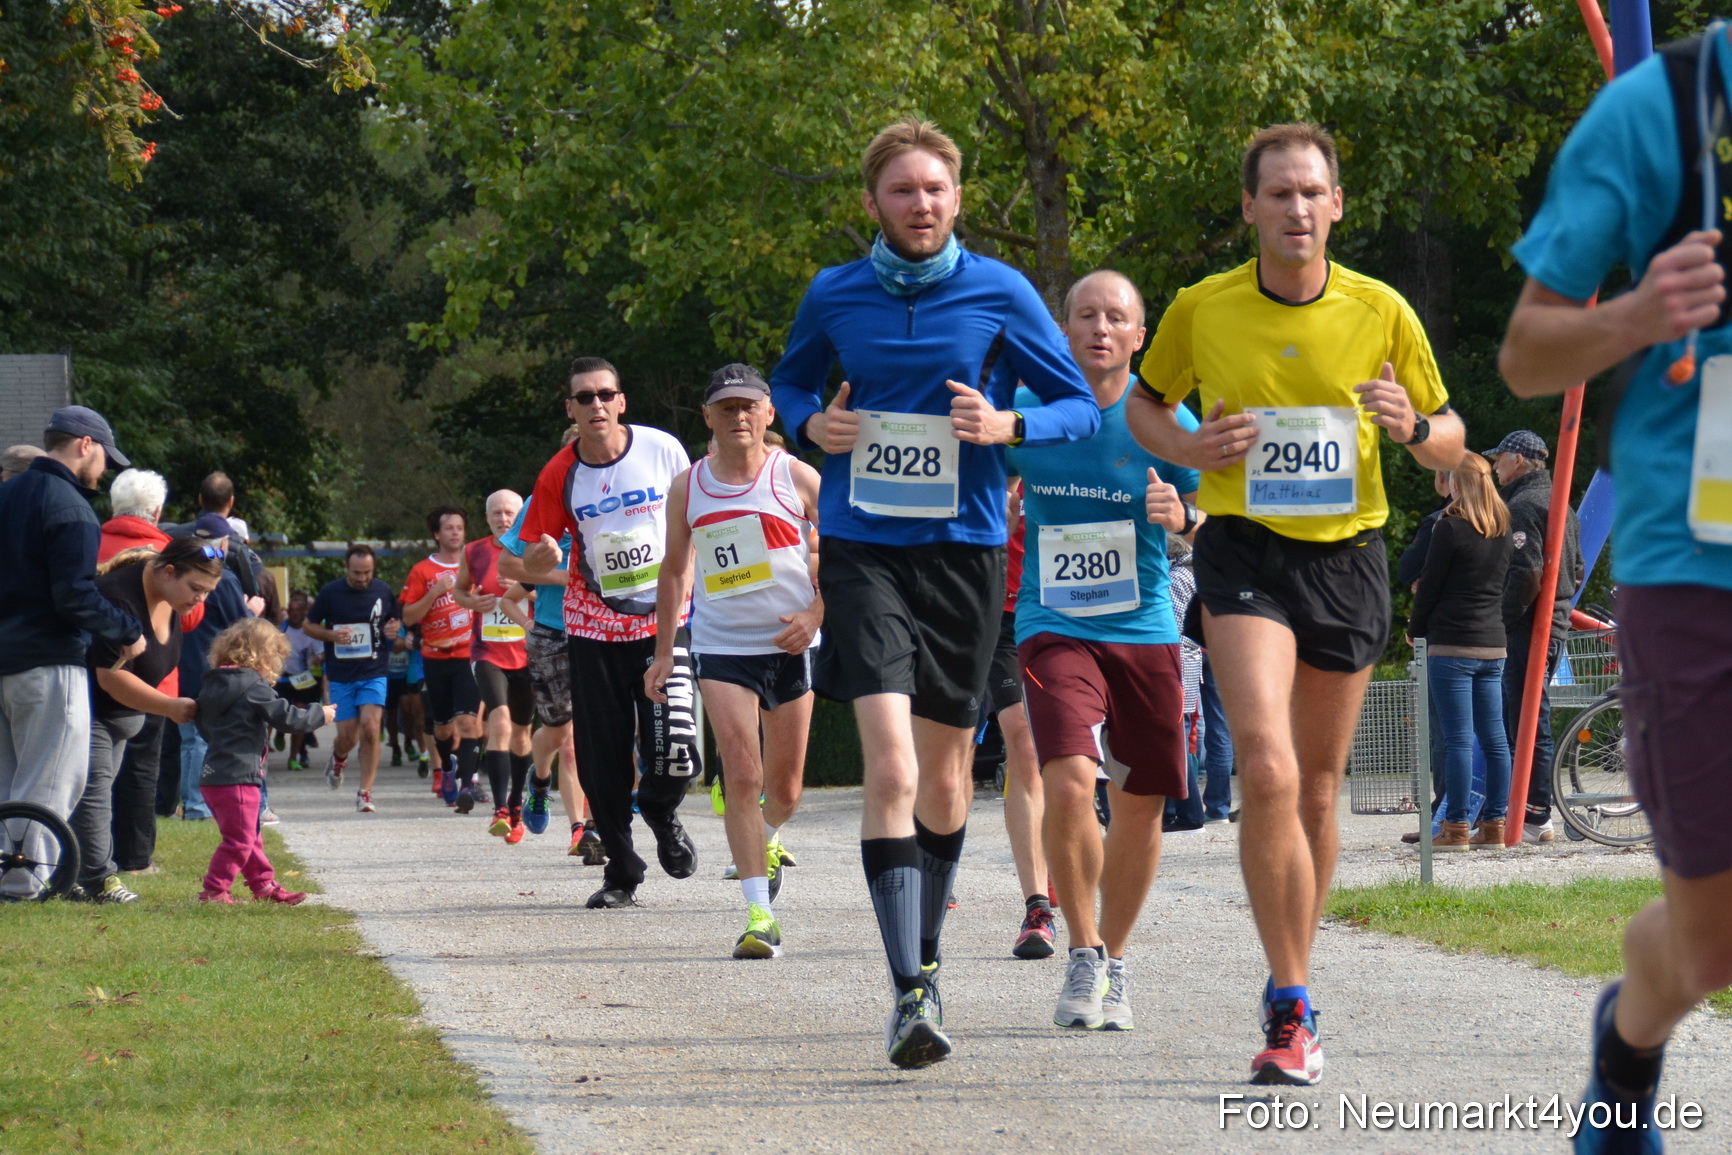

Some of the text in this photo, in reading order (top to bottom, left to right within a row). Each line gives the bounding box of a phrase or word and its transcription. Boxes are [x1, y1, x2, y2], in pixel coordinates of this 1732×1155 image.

[866, 443, 941, 477] 2928
[1262, 441, 1340, 473] 2940
[1031, 483, 1132, 503] www.hasit.de
[1253, 483, 1322, 502] Matthias
[604, 544, 654, 571] 5092
[714, 543, 740, 568] 61
[1054, 549, 1121, 581] 2380
[618, 572, 649, 584] Christian
[719, 571, 752, 585] Siegfried
[1070, 589, 1109, 602] Stephan
[654, 719, 664, 753] SINCE
[655, 757, 664, 776] 1992
